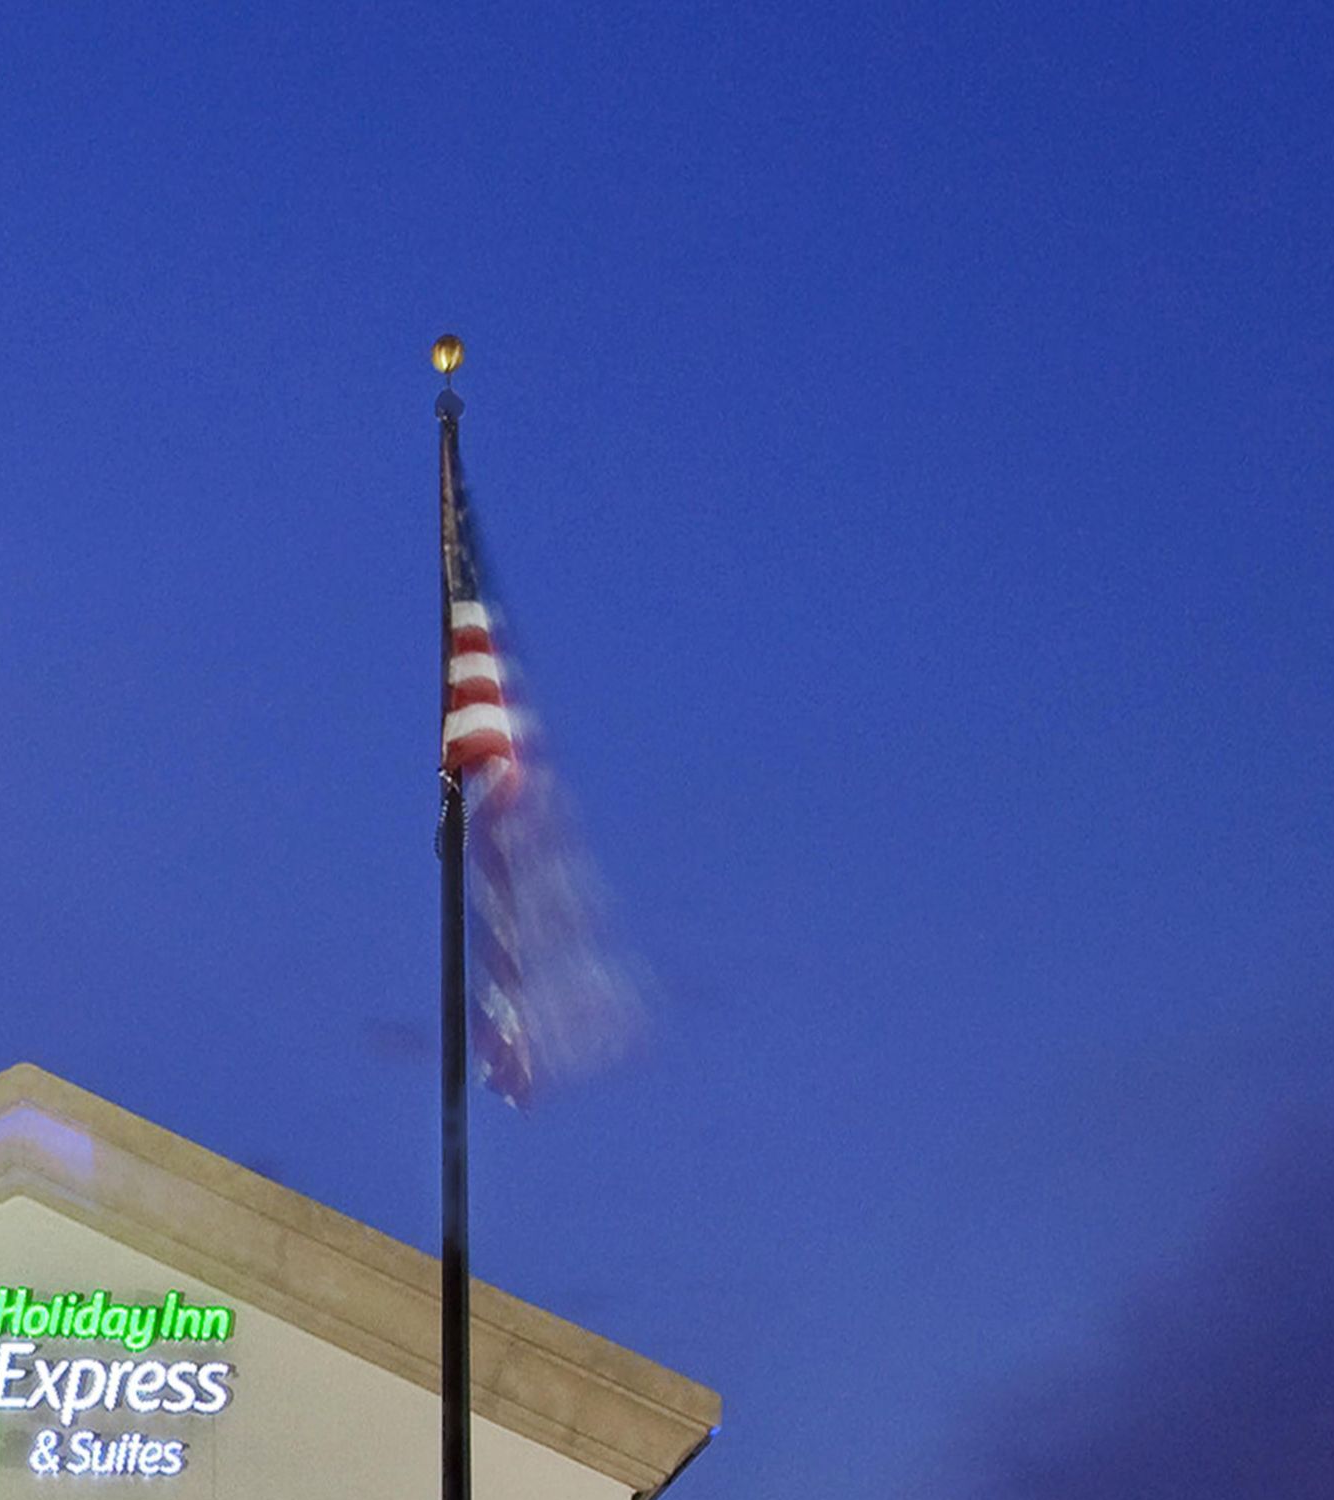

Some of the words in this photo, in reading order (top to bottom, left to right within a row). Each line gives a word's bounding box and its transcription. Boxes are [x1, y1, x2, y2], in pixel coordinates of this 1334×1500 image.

[159, 1289, 232, 1342] Inn
[28, 1429, 64, 1475] &
[65, 1431, 185, 1476] Suites
